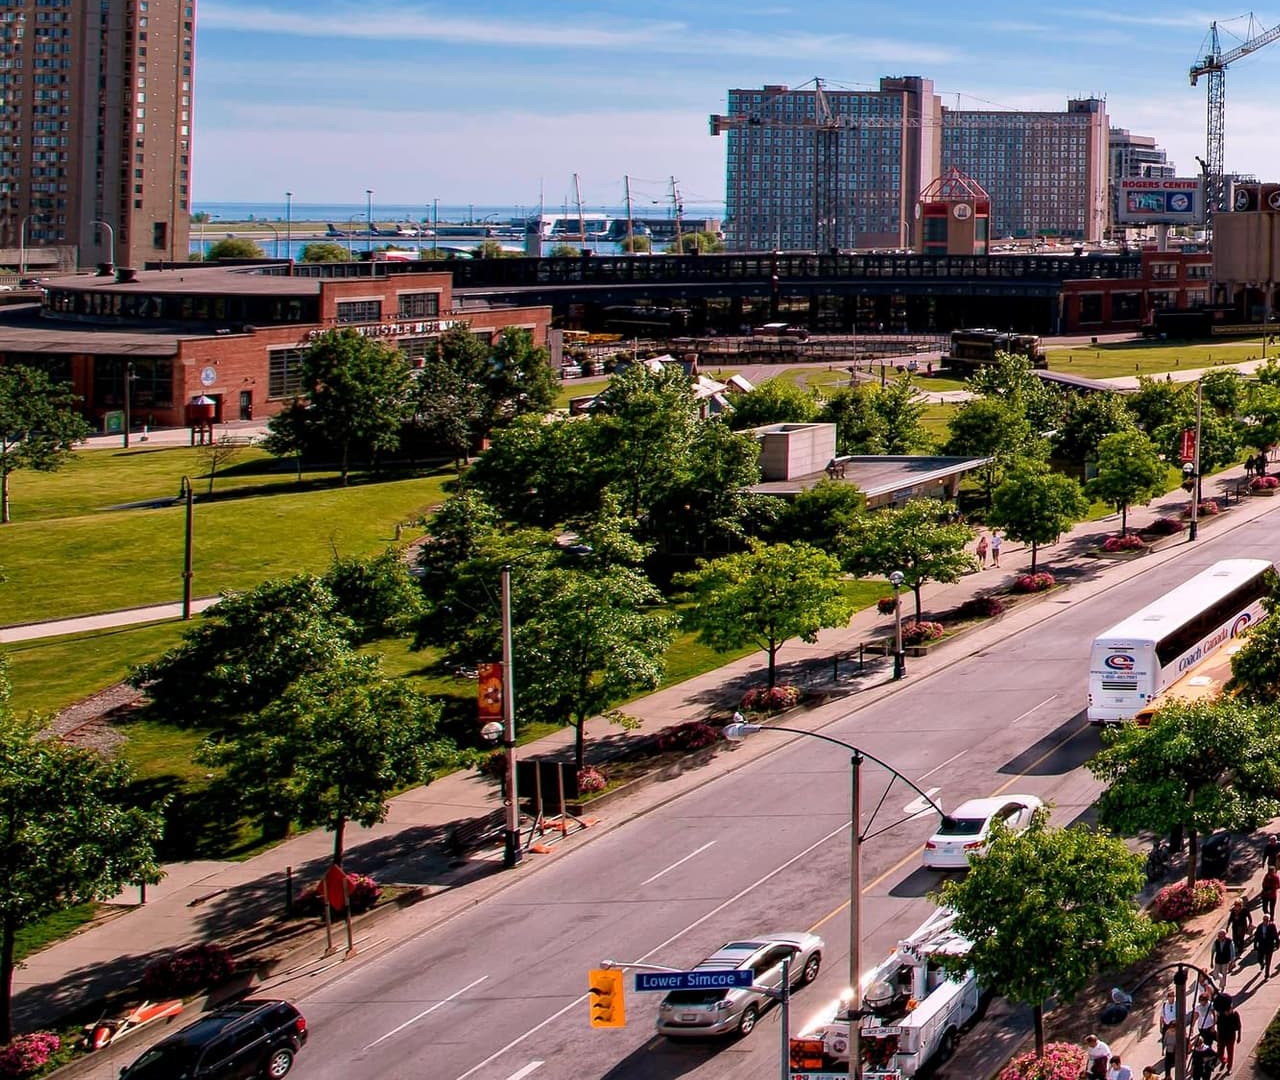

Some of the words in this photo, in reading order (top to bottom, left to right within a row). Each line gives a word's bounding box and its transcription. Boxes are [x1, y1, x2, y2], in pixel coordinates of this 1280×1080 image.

[1122, 181, 1160, 189] ROGERS
[1162, 181, 1199, 189] CENTRE
[1178, 647, 1202, 672] Coach
[1203, 627, 1229, 654] Canada
[643, 975, 683, 988] Lower
[687, 973, 736, 986] Simcoe
